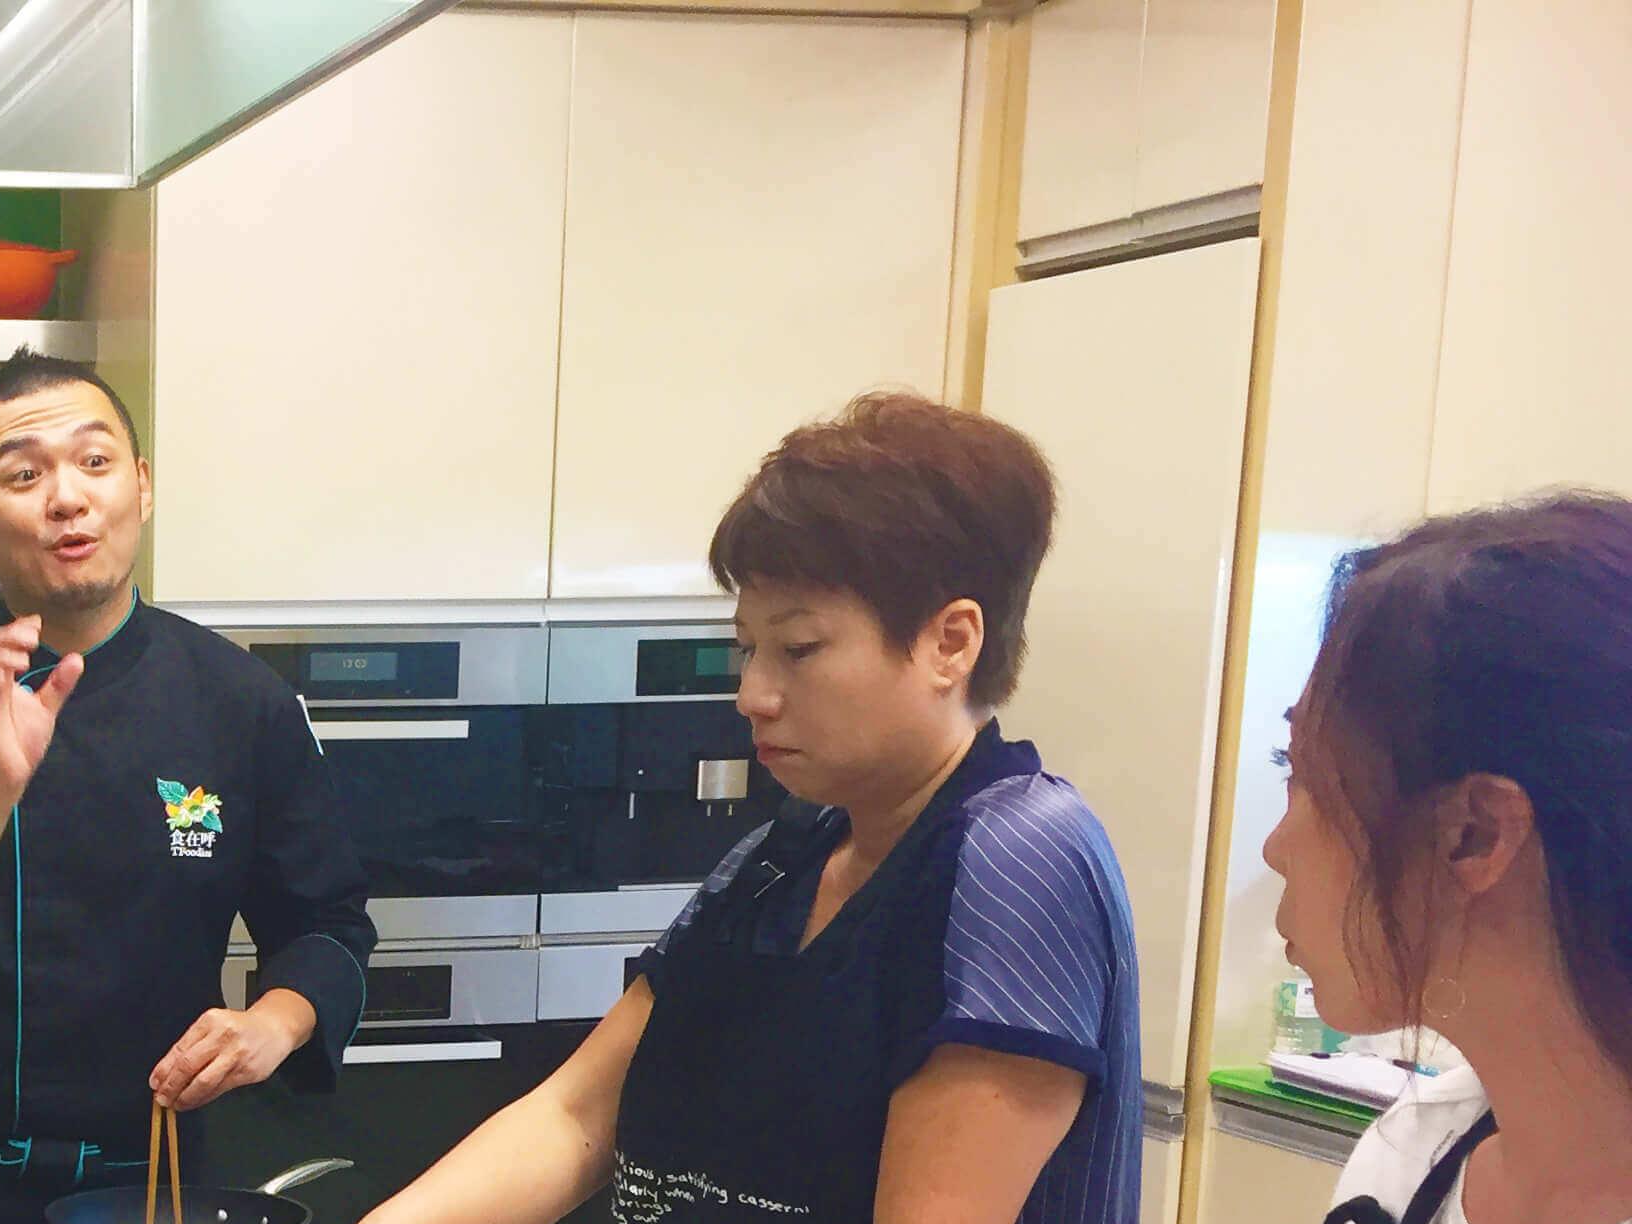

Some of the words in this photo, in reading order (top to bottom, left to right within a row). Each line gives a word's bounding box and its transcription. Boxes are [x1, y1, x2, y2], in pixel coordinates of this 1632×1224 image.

[169, 829, 216, 848] 食在呼
[666, 1171, 729, 1204] satisfying
